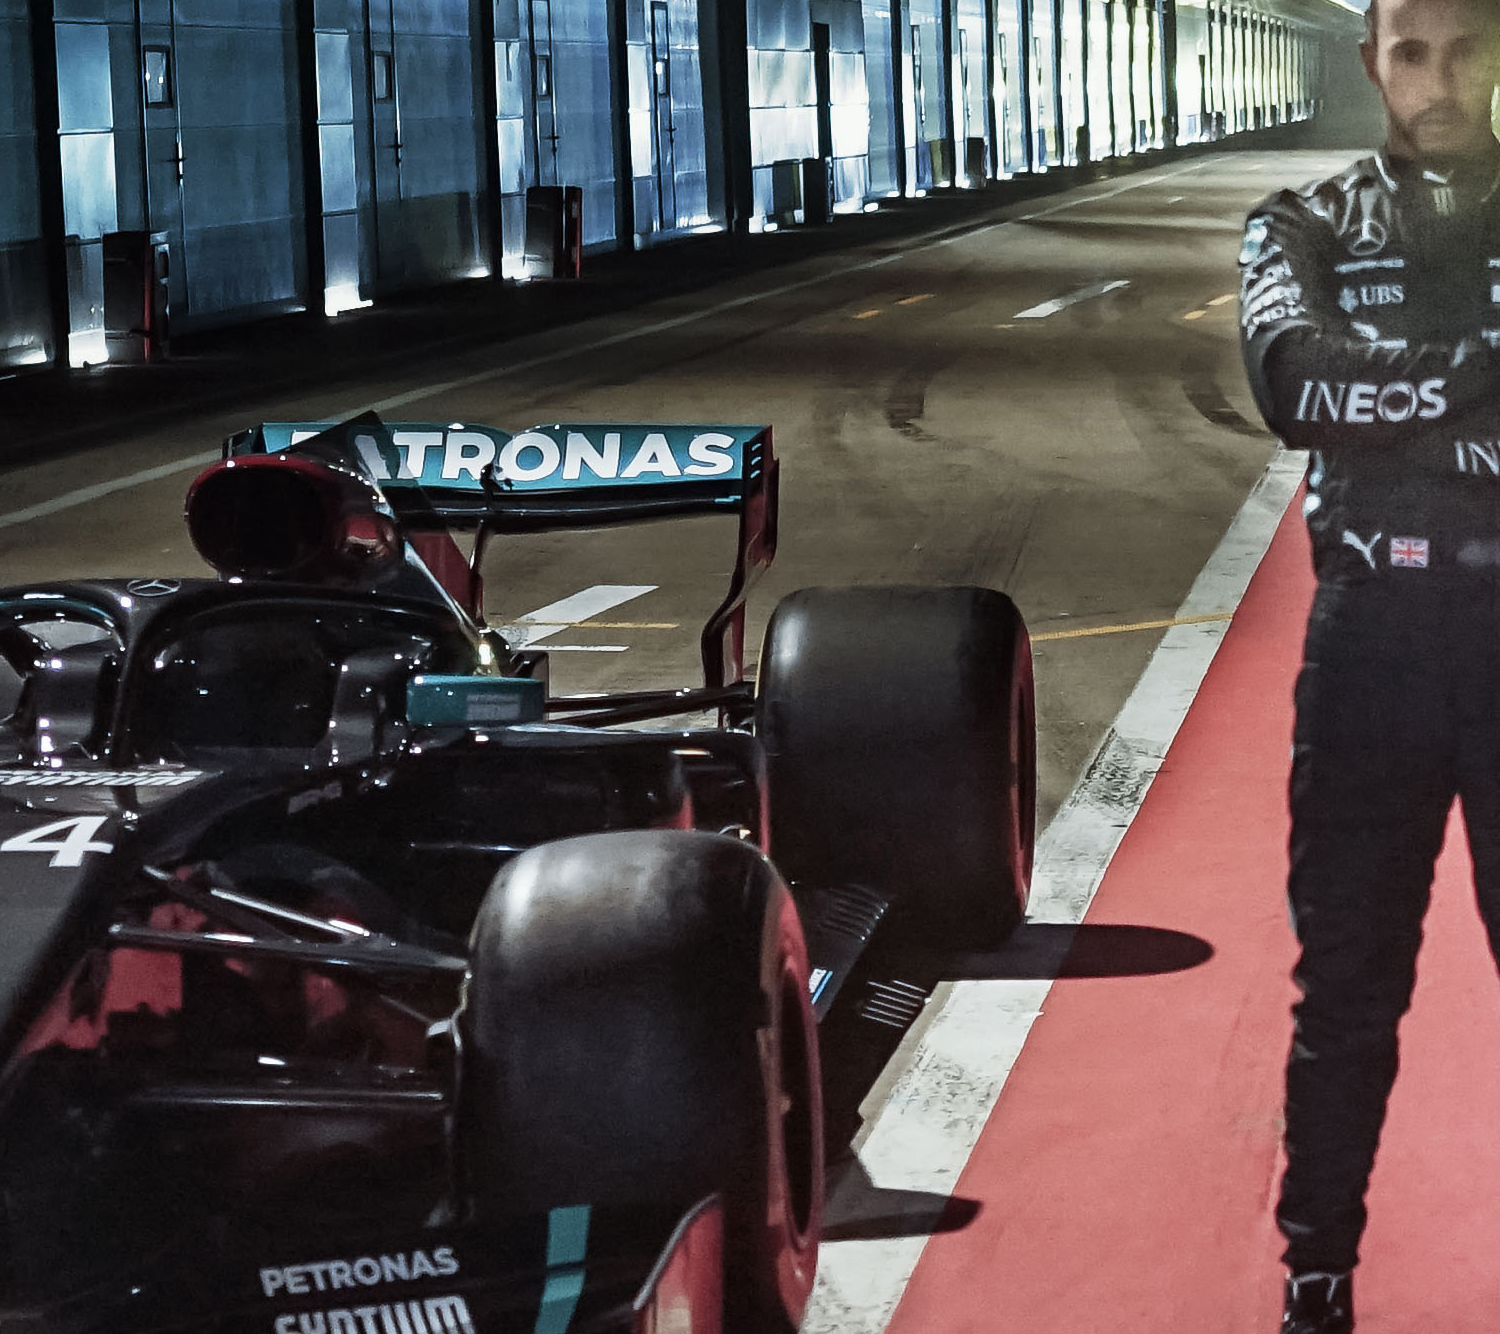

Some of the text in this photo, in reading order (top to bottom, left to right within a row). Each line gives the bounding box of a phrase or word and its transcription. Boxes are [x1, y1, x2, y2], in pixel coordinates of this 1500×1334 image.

[1361, 284, 1404, 305] UBS
[1297, 378, 1447, 423] INEOS
[290, 430, 737, 481] TRONAS
[259, 1245, 460, 1298] PETRONAS
